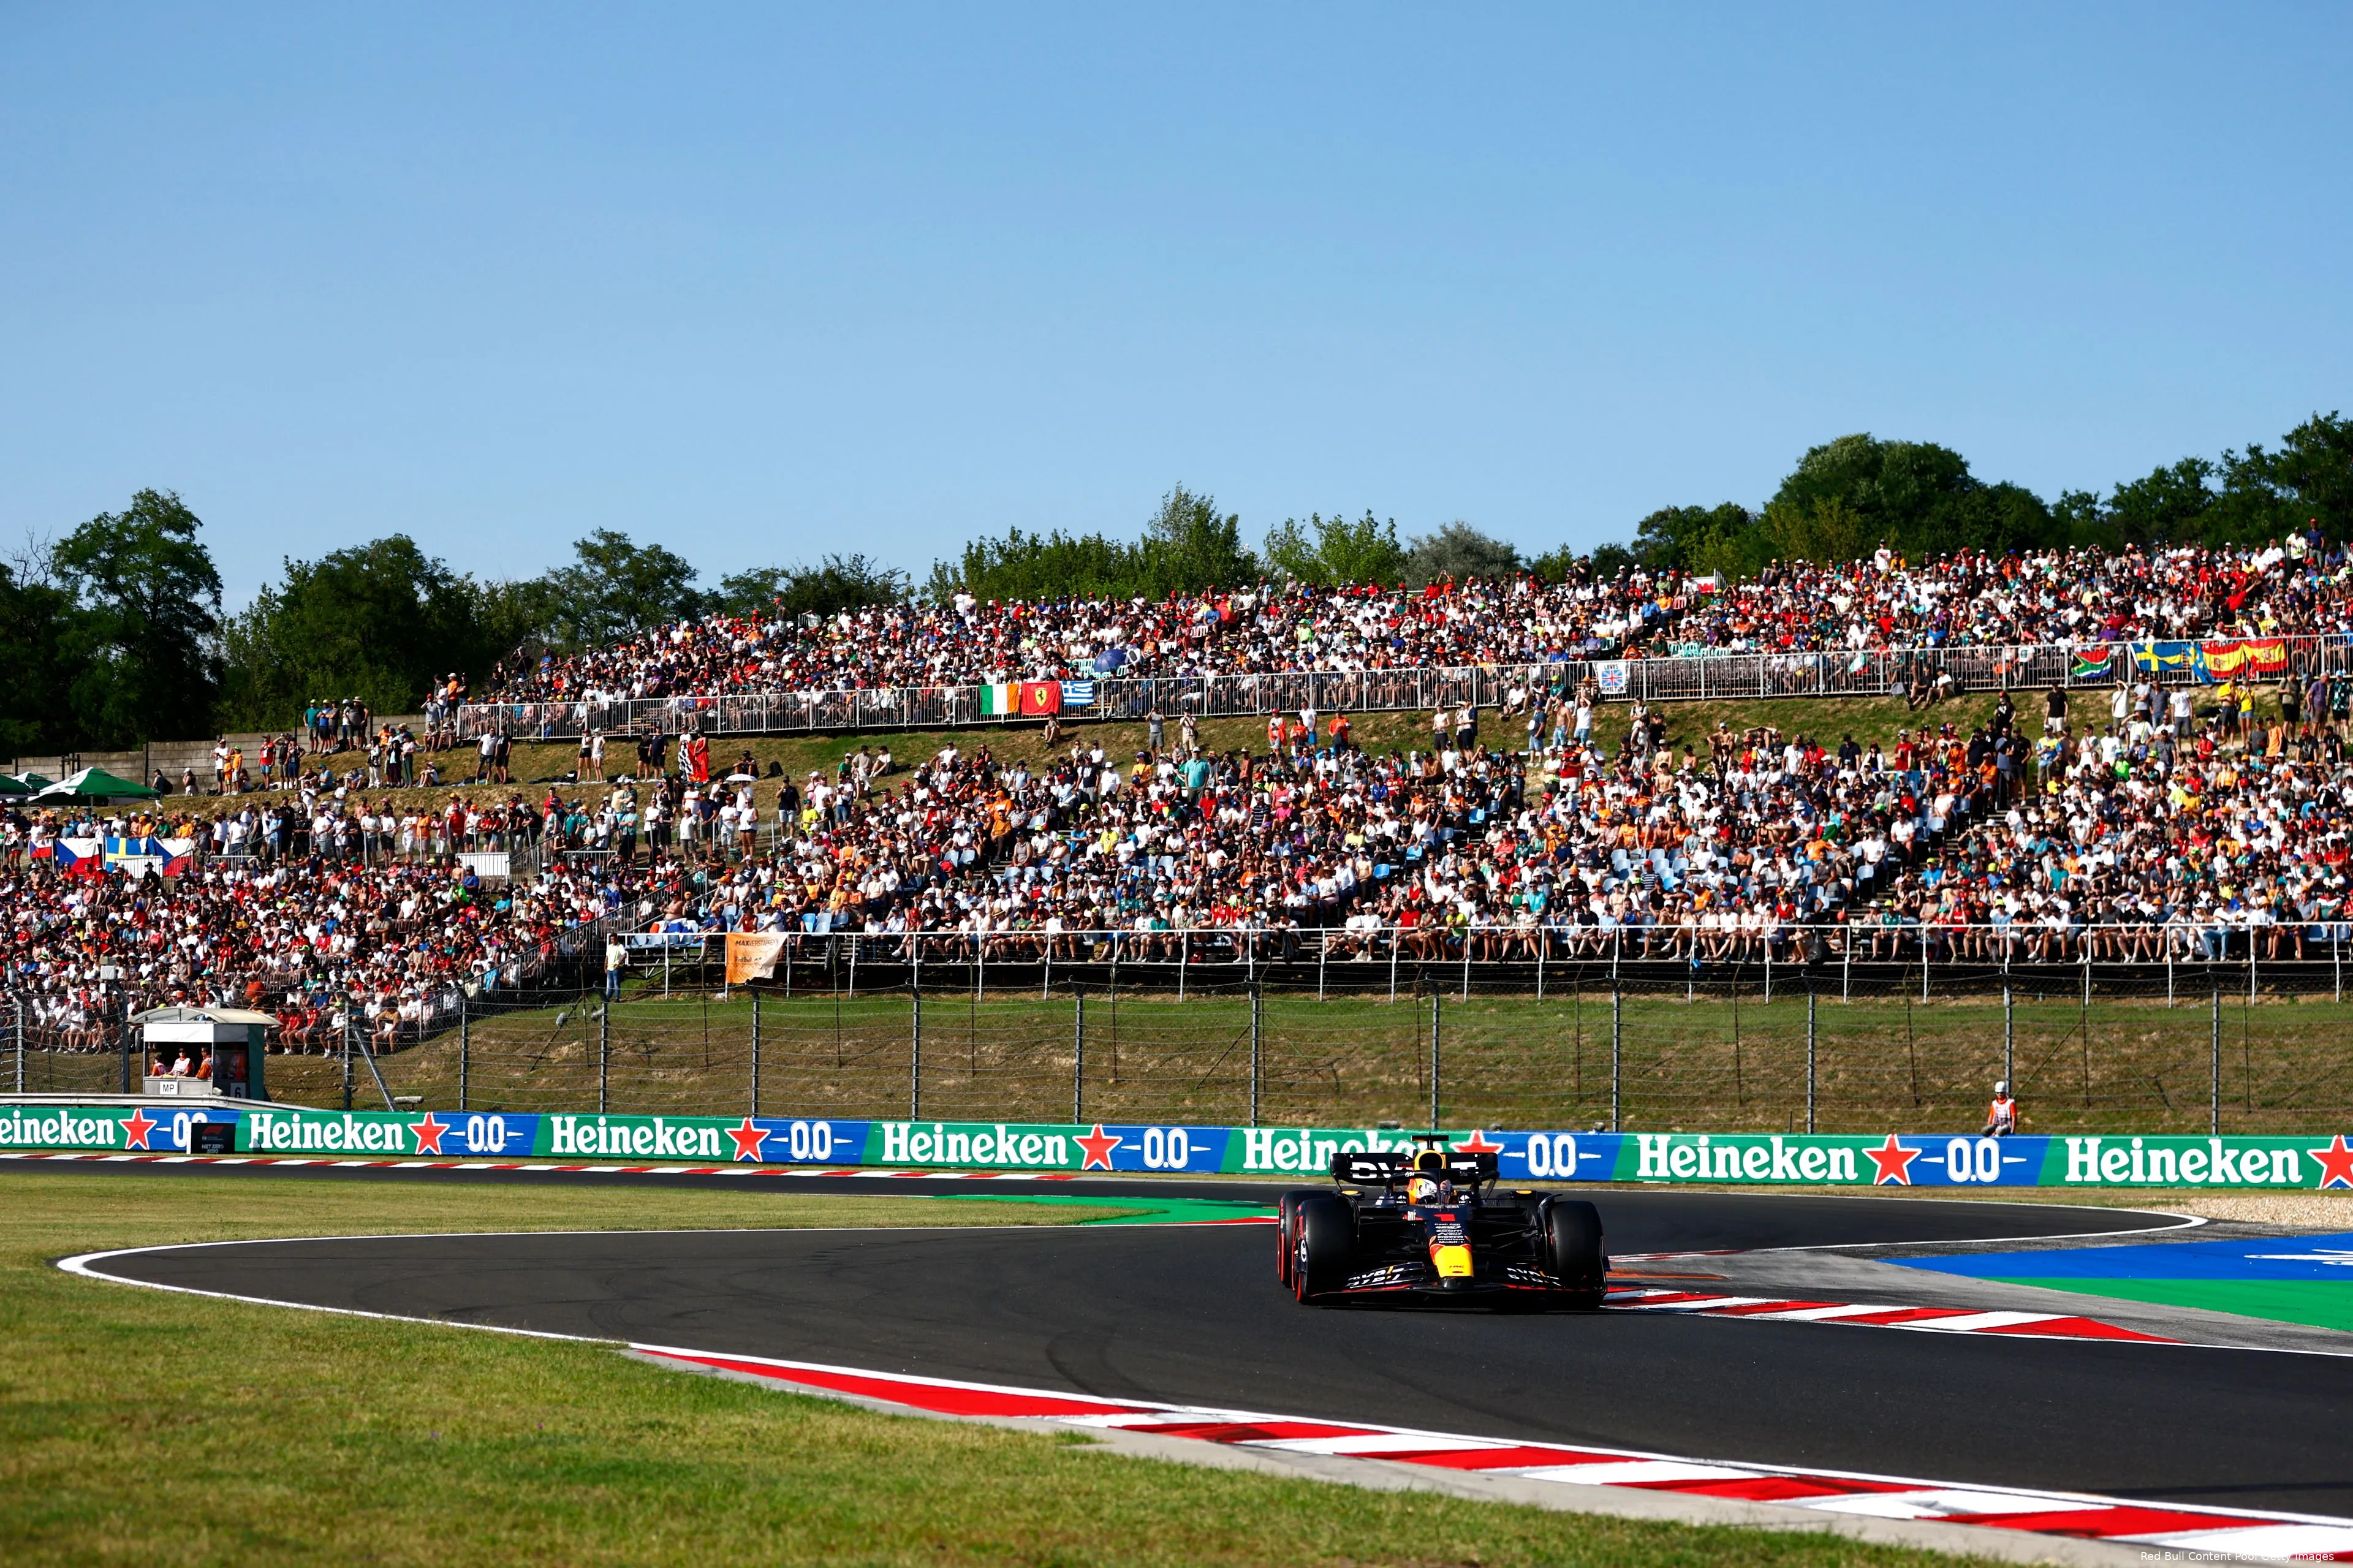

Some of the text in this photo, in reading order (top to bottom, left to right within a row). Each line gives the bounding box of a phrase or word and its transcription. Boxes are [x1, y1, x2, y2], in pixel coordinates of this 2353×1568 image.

[235, 1087, 241, 1098] 6
[0, 1110, 115, 1145] eineken
[249, 1113, 404, 1150] Heineken
[468, 1116, 506, 1153] 0.0
[551, 1116, 831, 1159] Heineken 0.0
[881, 1123, 1188, 1168] Heineken 0.0
[1528, 1134, 1575, 1176] 0.0
[1635, 1134, 1999, 1183] Heineken 0.0
[2066, 1137, 2302, 1183] Heineken
